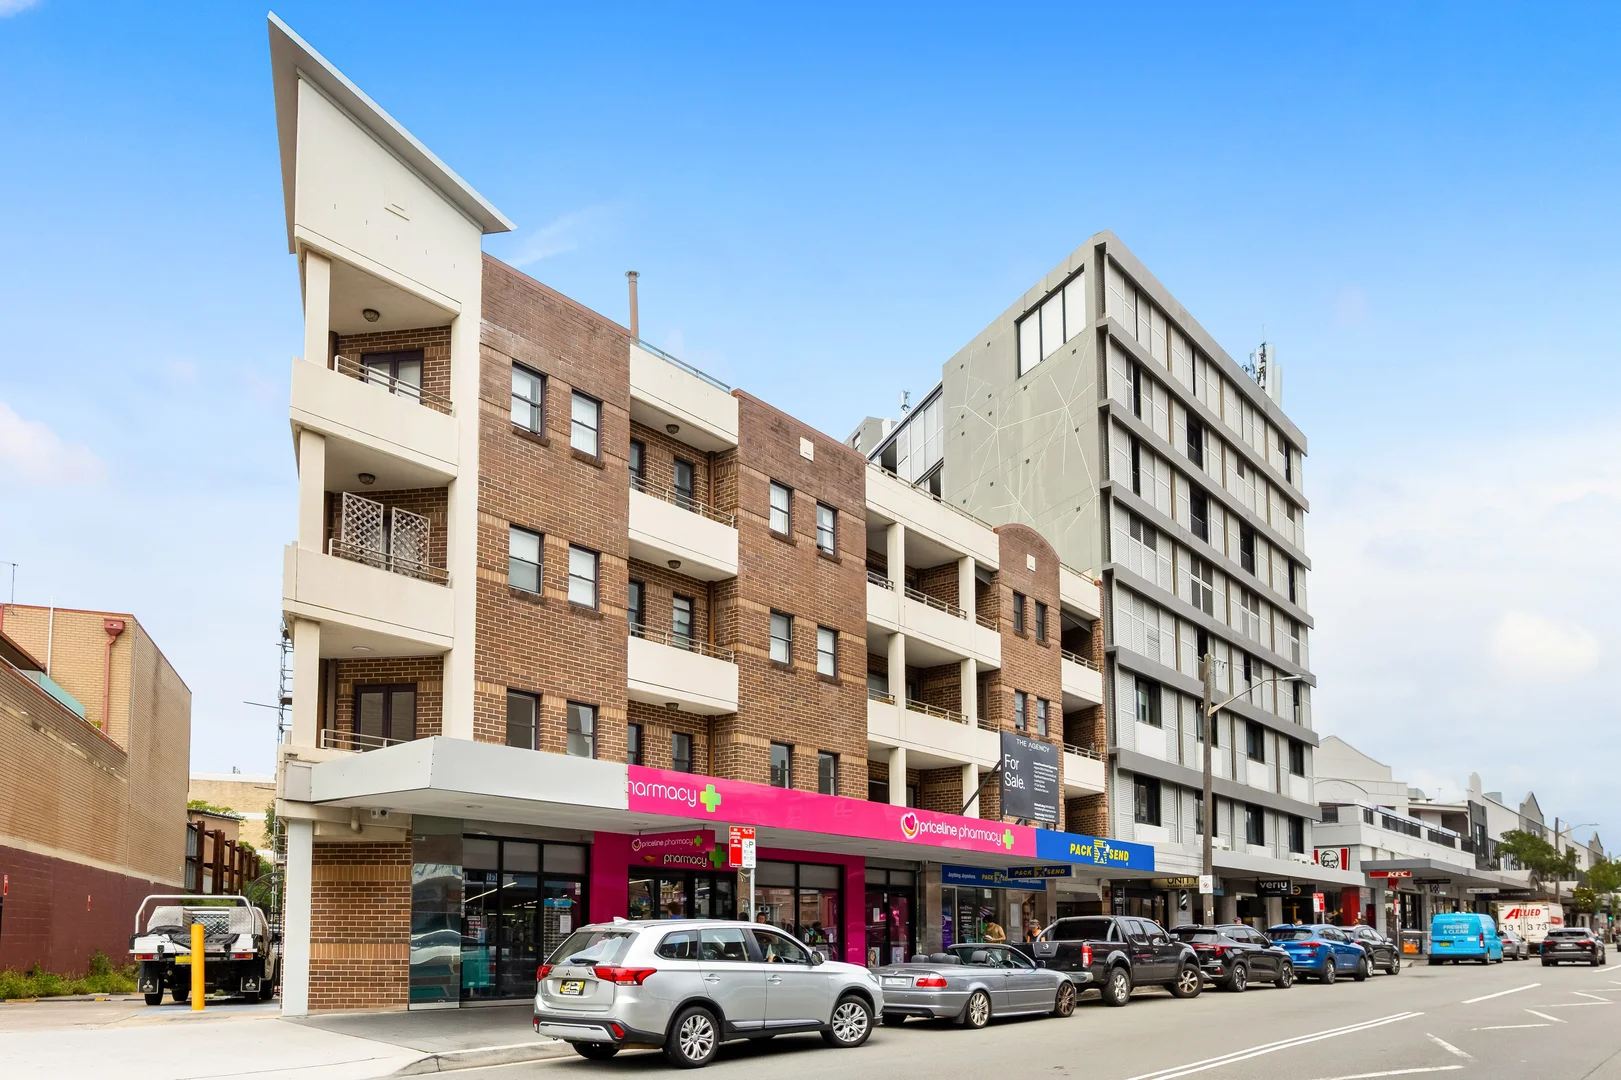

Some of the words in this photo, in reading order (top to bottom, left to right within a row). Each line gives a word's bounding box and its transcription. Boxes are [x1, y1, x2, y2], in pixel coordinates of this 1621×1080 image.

[1016, 738, 1027, 747] THE
[1028, 742, 1050, 753] AGENCY
[1004, 753, 1020, 770] For
[1004, 771, 1026, 790] Sale.
[920, 821, 957, 836] priceline
[958, 825, 1002, 847] pharmacy
[641, 840, 664, 848] priceline
[664, 838, 694, 847] pharmacy
[1069, 843, 1092, 857] PACK
[1109, 849, 1129, 861] SEND
[663, 853, 707, 868] pharmacy
[1167, 877, 1198, 885] UNITY
[1504, 908, 1541, 919] ALLIED
